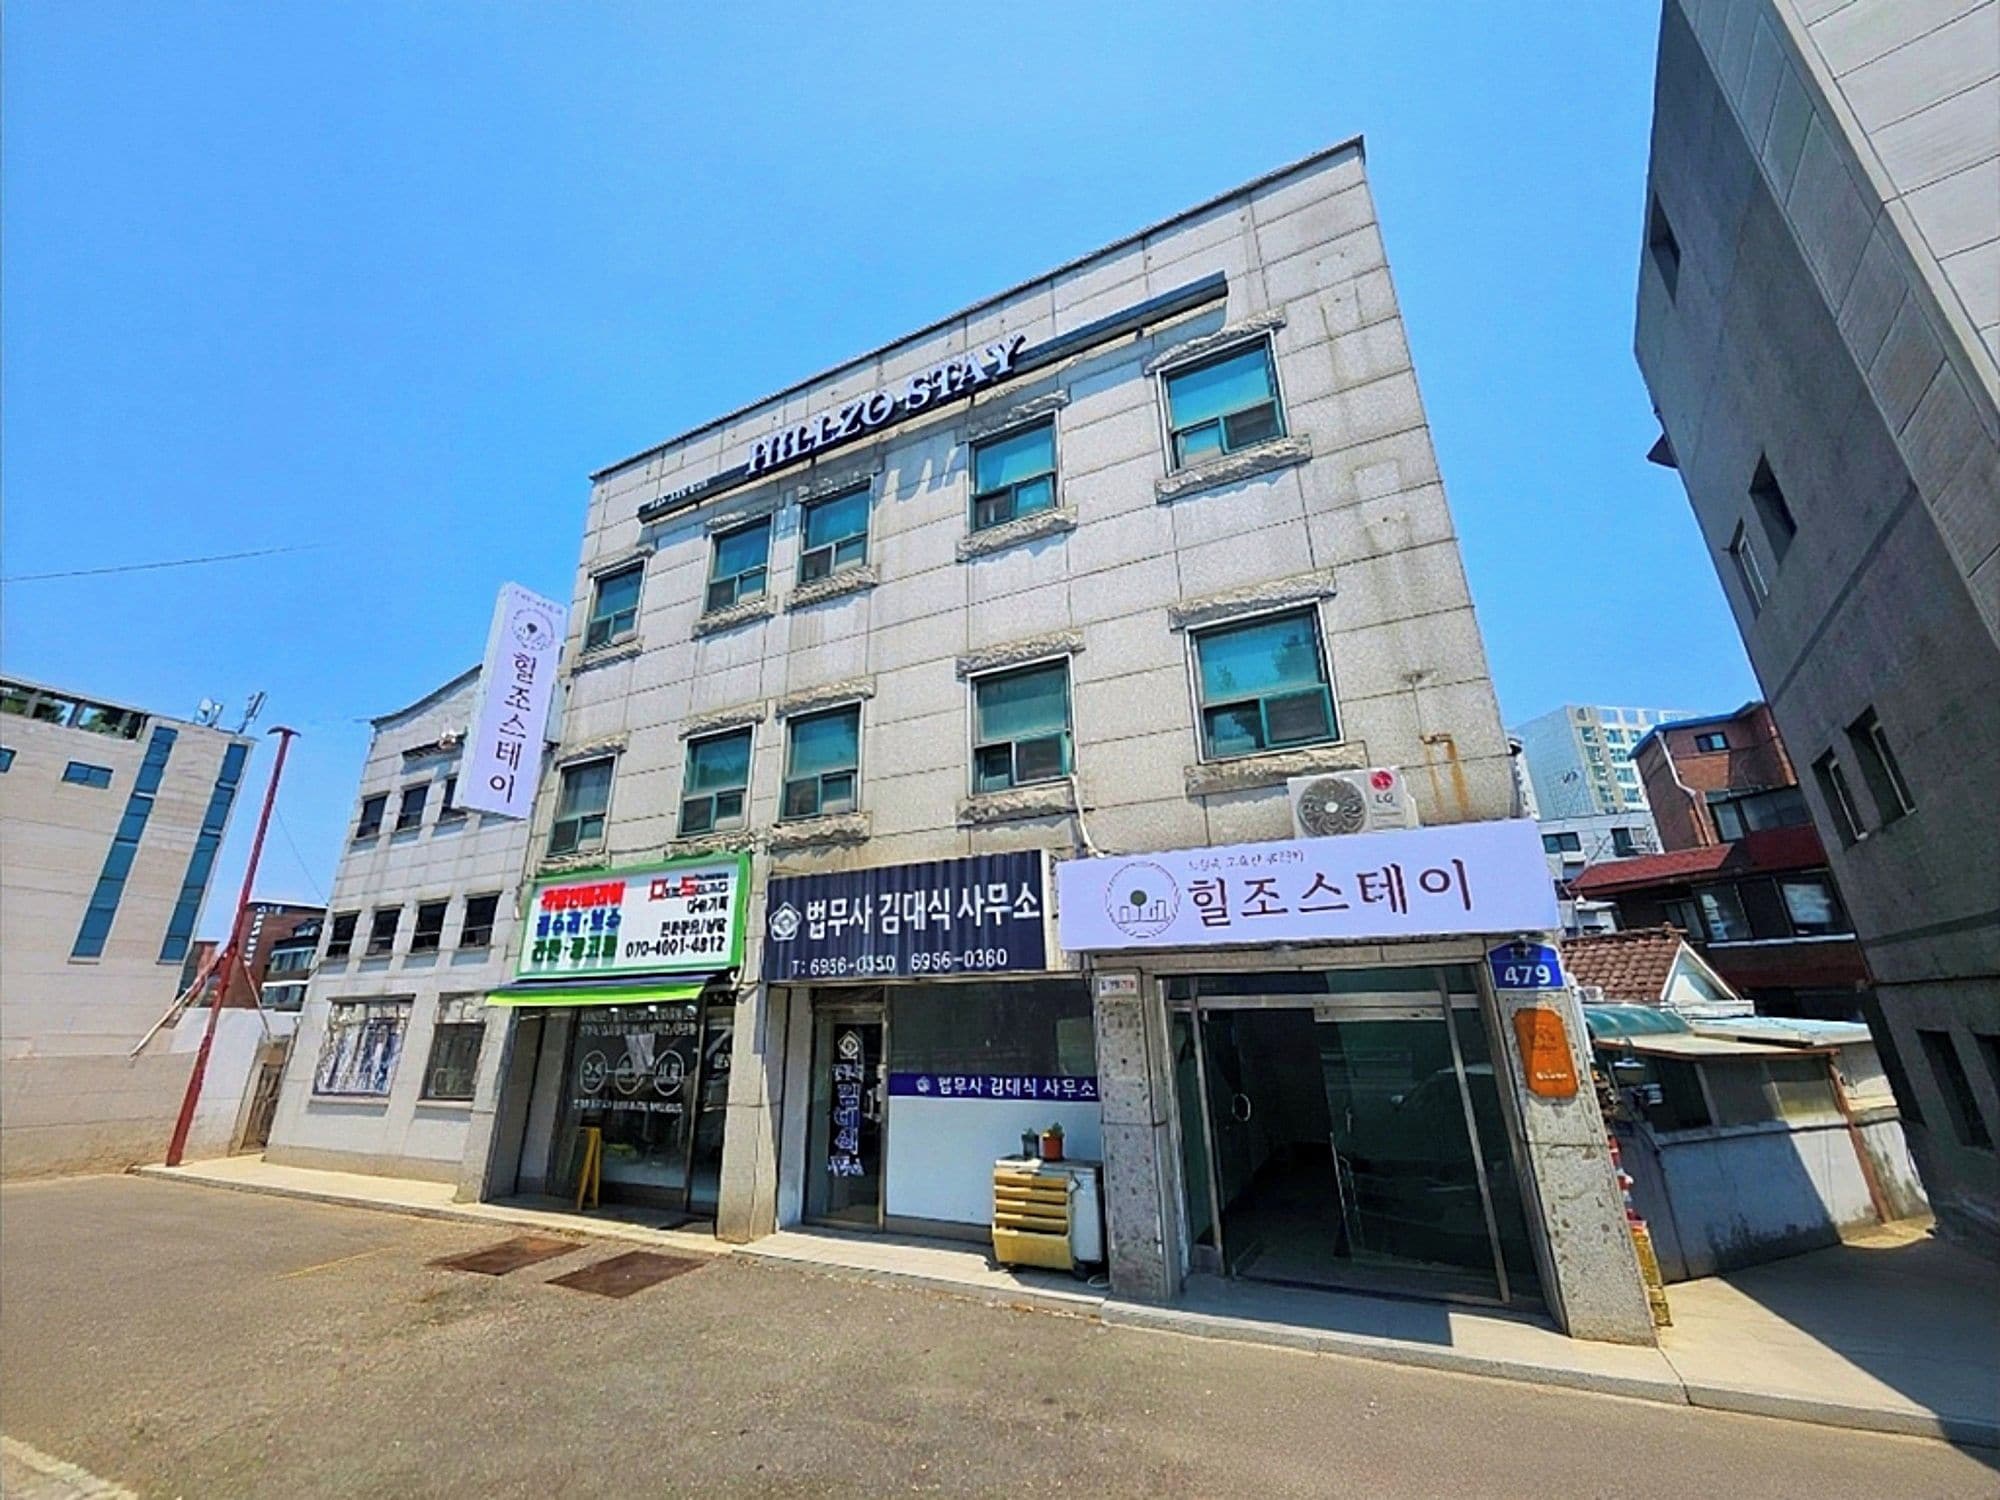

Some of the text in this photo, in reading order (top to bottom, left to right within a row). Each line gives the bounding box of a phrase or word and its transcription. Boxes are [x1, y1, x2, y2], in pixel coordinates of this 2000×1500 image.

[746, 334, 1027, 476] HILLZO STAY
[489, 652, 537, 803] 힐조스테이
[1375, 793, 1393, 803] LG
[806, 882, 1041, 940] 법무사 김대식 사무소
[1187, 859, 1471, 927] 힐조스테이
[911, 948, 1007, 971] 6956-0360
[1505, 965, 1550, 985] 479
[938, 1076, 1097, 1098] 법무사 김대식 사무소
